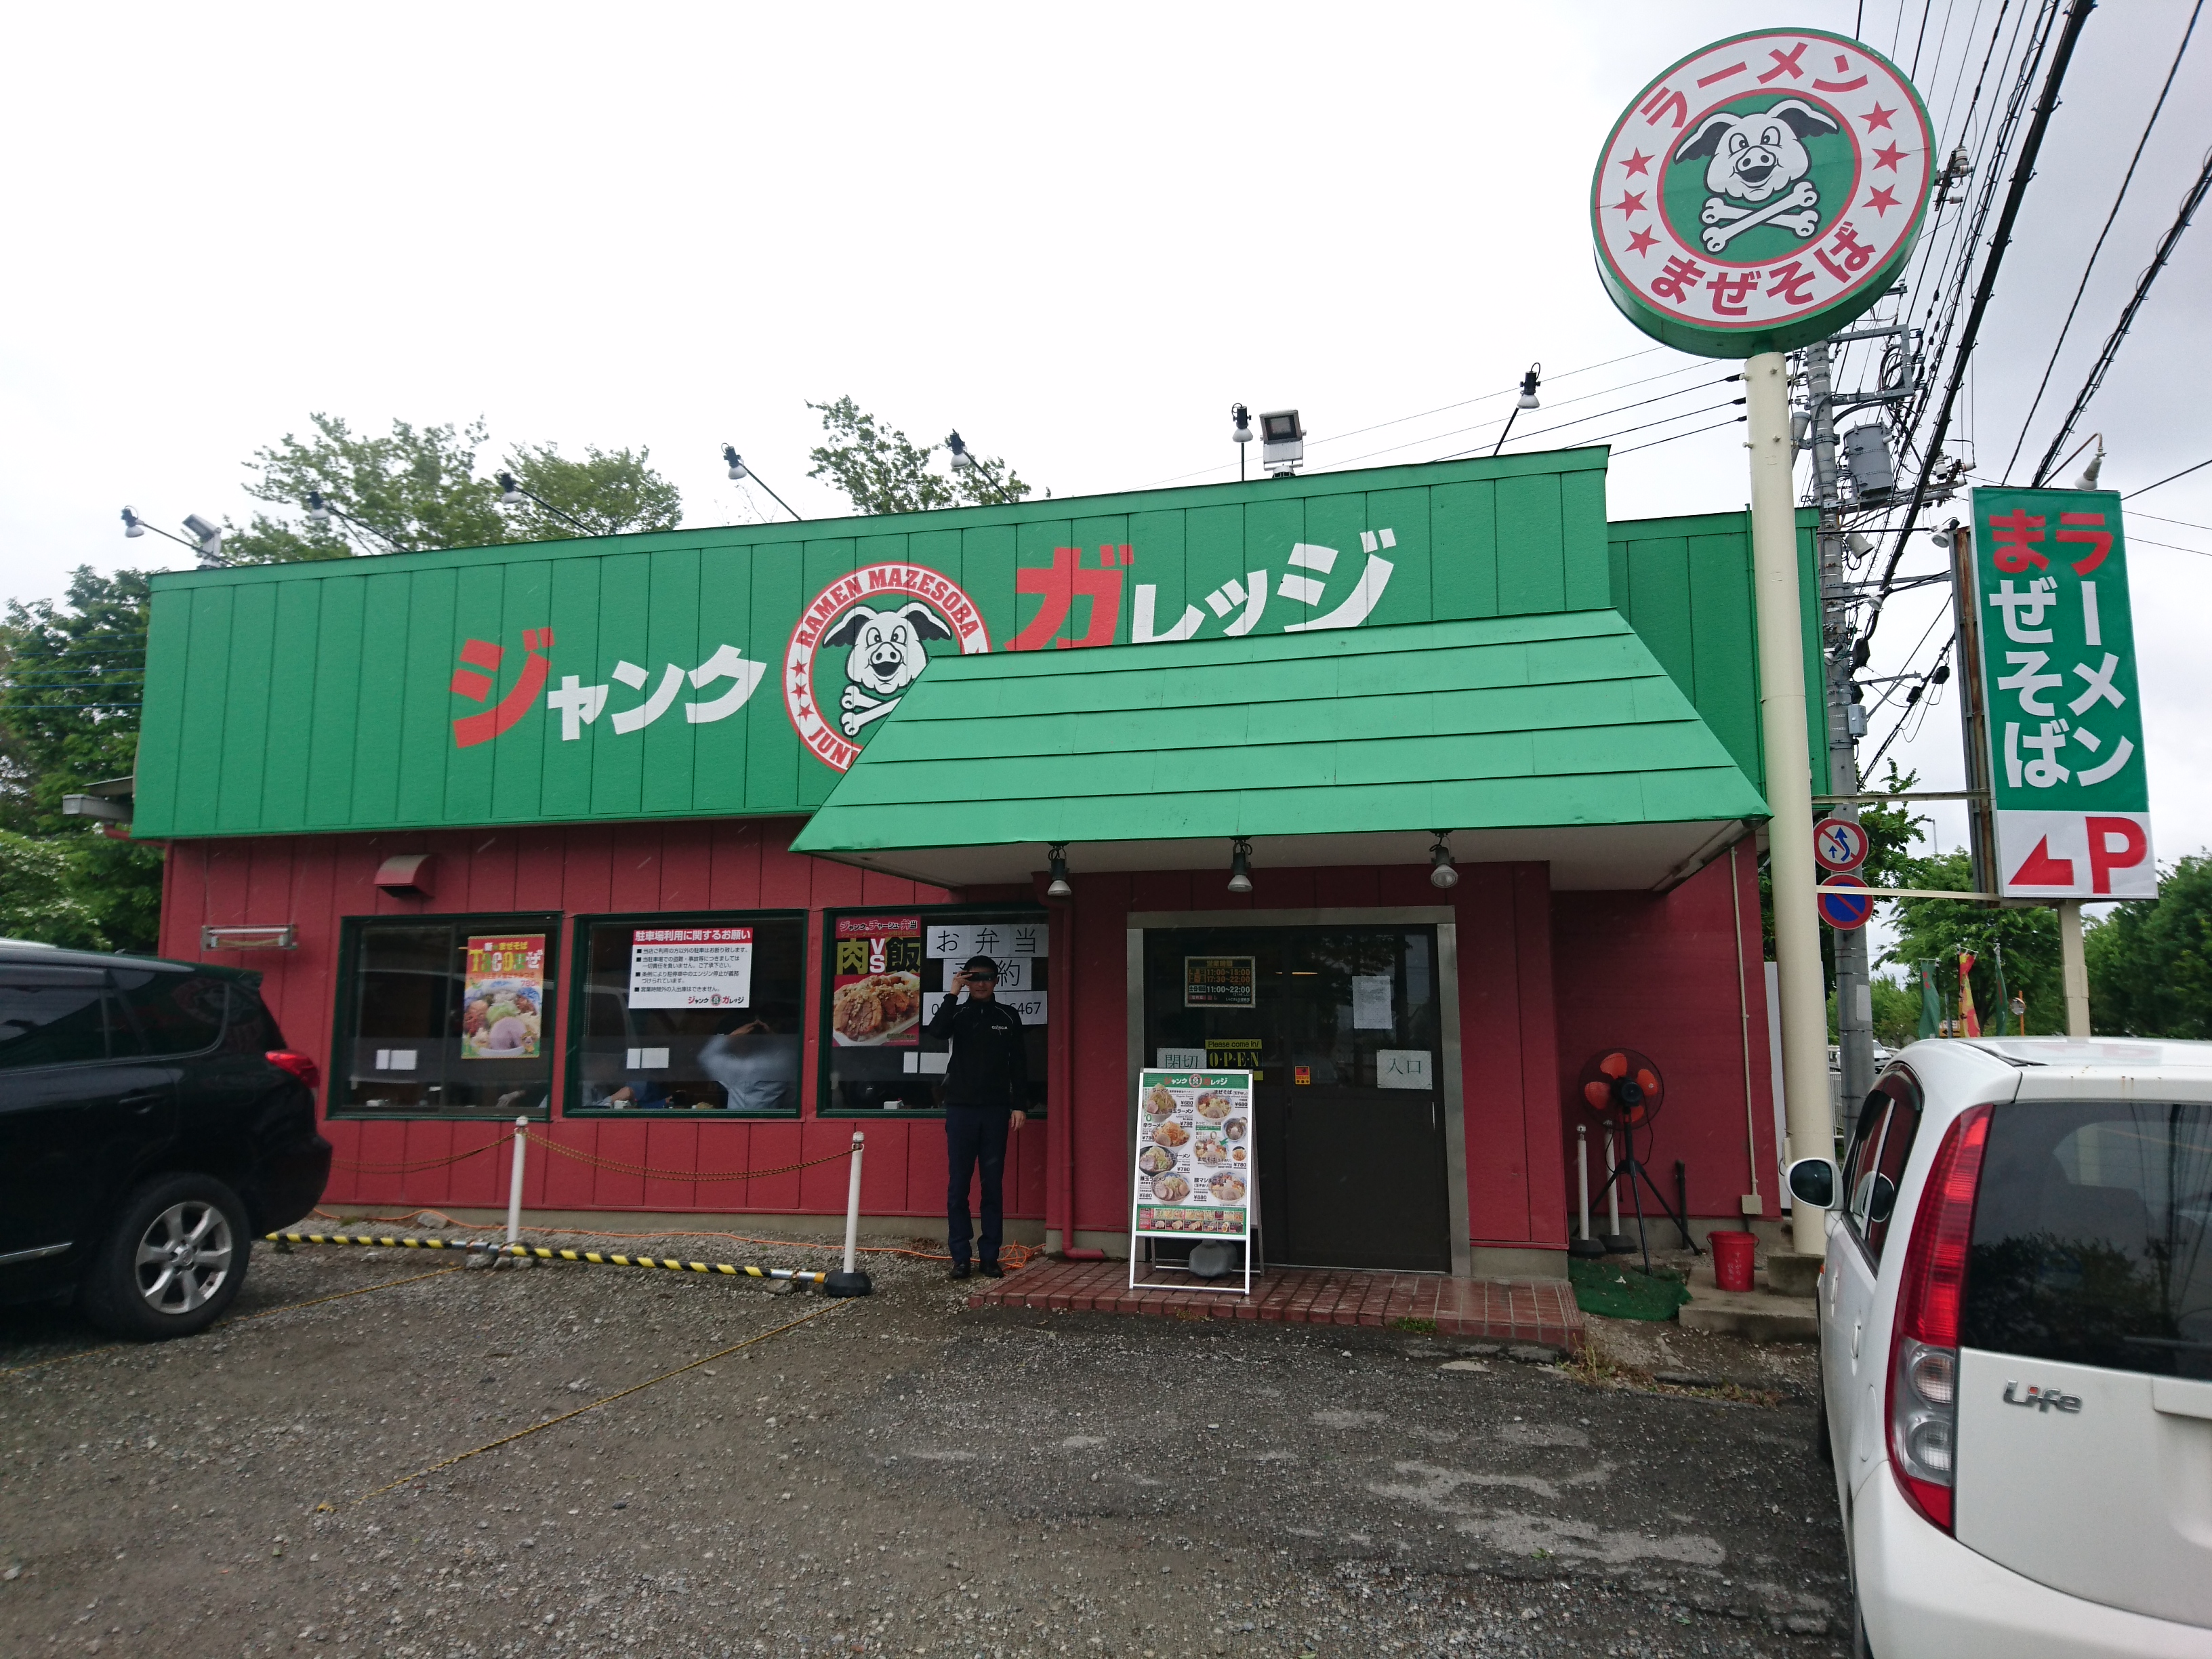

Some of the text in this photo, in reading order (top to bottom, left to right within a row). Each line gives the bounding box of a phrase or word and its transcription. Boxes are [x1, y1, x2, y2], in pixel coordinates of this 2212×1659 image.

[1640, 42, 1868, 128] ラーメン
[1650, 222, 1876, 316] まぜそば
[449, 528, 1397, 748] ジャンク ガレッジ
[796, 568, 980, 649] RAMEN MAZESOBA
[1988, 508, 2070, 789] まぜそば
[2055, 512, 2134, 787] ラーメン
[2085, 817, 2148, 894] P
[635, 930, 751, 942] 駐車場利用に関するお願い
[836, 937, 920, 975] 肉 VS 飯
[937, 927, 1036, 954] お弁当
[688, 996, 709, 1004] ジャンク
[1386, 1058, 1421, 1075] 入口
[2003, 1380, 2083, 1414] Life
